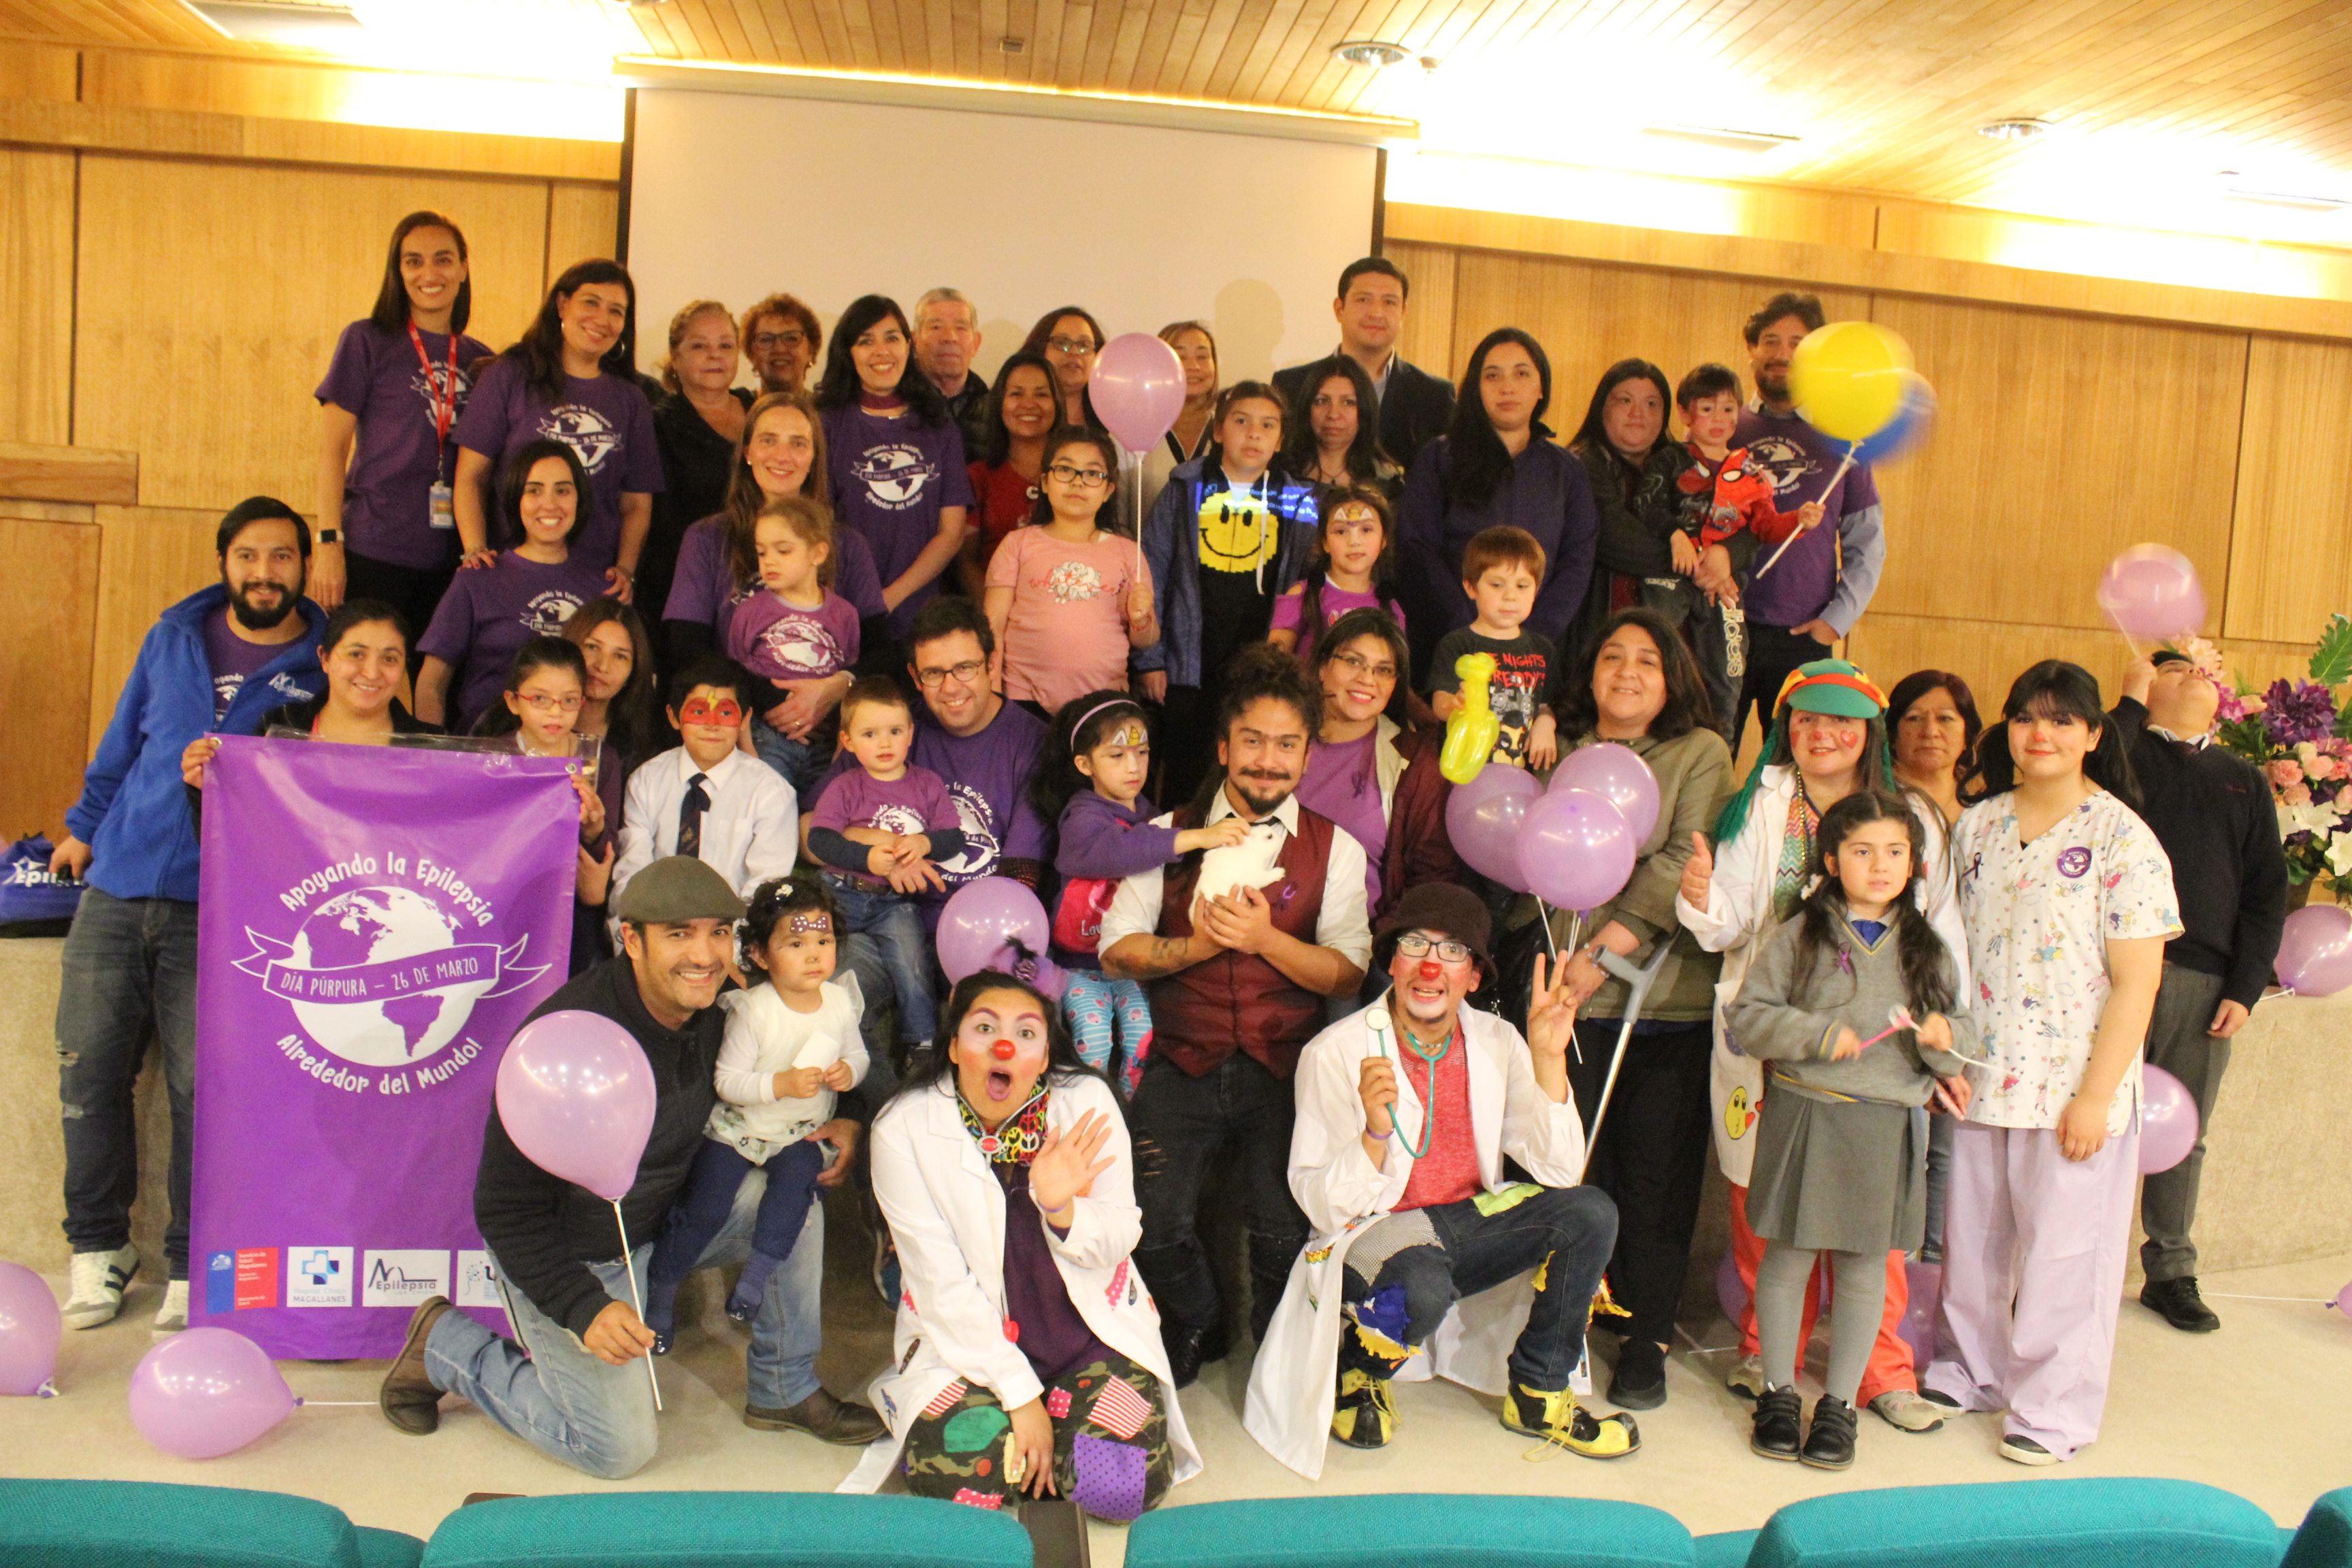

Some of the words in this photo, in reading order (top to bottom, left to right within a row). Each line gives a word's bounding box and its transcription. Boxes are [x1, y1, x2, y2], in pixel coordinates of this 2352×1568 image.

[1502, 653, 1546, 669] NIGHTS
[214, 673, 244, 684] oyando
[280, 852, 376, 912] Apoyando
[387, 851, 406, 875] la
[416, 859, 494, 927] Epilepsia
[391, 972, 409, 991] 26
[413, 967, 431, 985] DE
[436, 958, 478, 979] MARZO
[276, 1034, 370, 1094] Alrededor
[378, 1073, 410, 1095] del
[416, 1036, 483, 1089] Mundo!
[376, 1280, 436, 1292] Epilepsia
